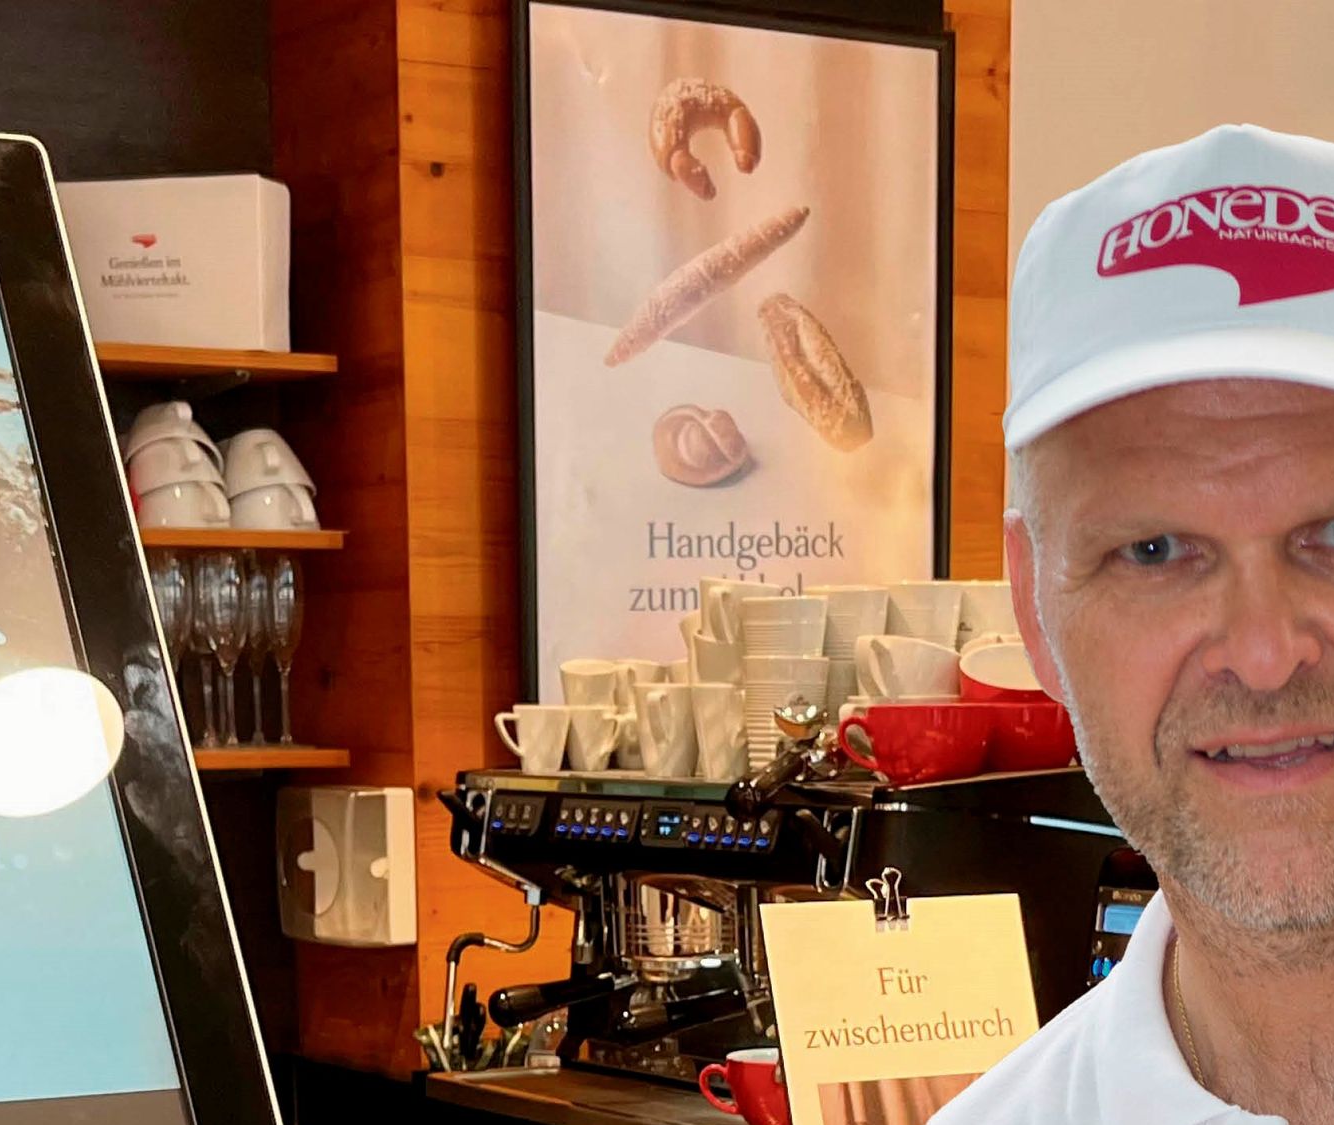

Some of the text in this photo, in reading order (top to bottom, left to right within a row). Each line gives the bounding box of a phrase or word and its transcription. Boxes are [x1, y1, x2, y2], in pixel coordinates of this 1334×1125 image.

[647, 521, 845, 571] Handgebäck
[628, 587, 699, 611] zum
[877, 967, 929, 995] Für
[804, 1008, 1014, 1049] zwischendurch
